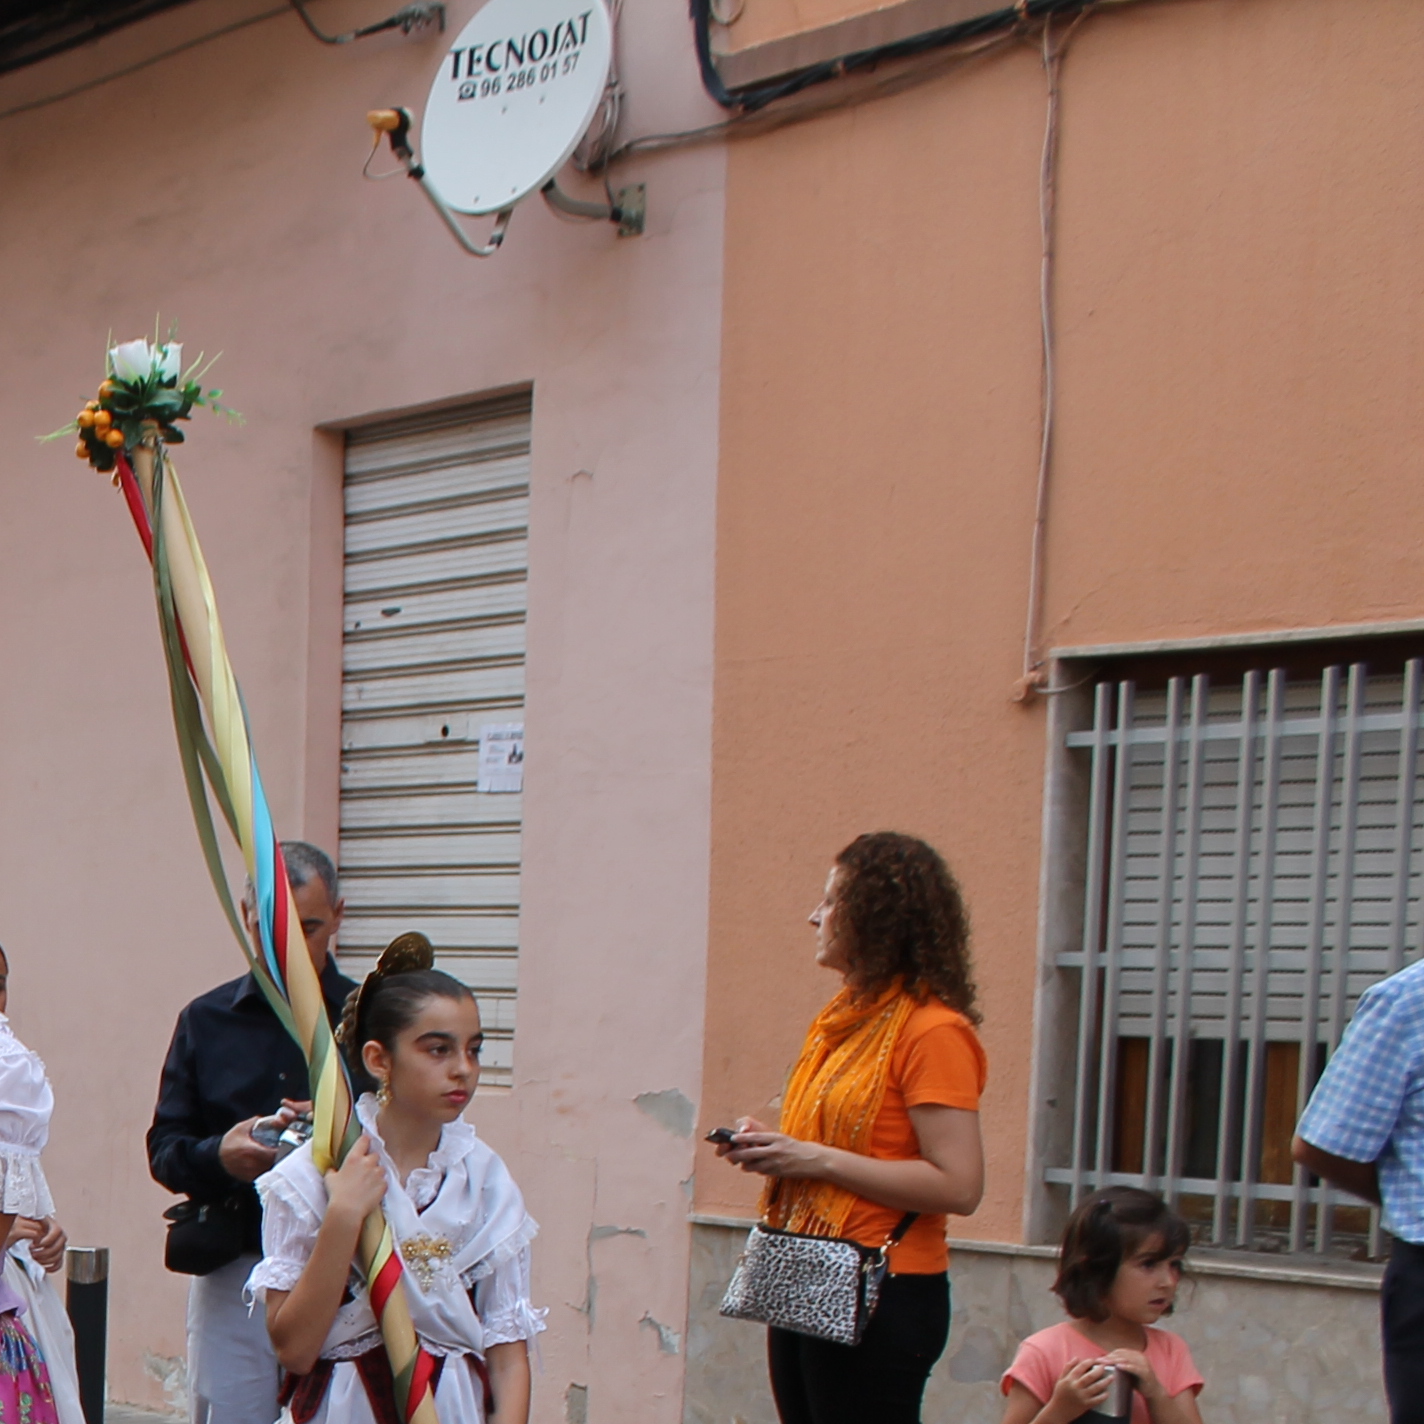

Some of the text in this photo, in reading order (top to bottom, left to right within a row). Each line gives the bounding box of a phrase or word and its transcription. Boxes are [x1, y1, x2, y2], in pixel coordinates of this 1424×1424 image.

[450, 9, 593, 80] TECNOSAT
[480, 50, 581, 98] 96 286 01 57
